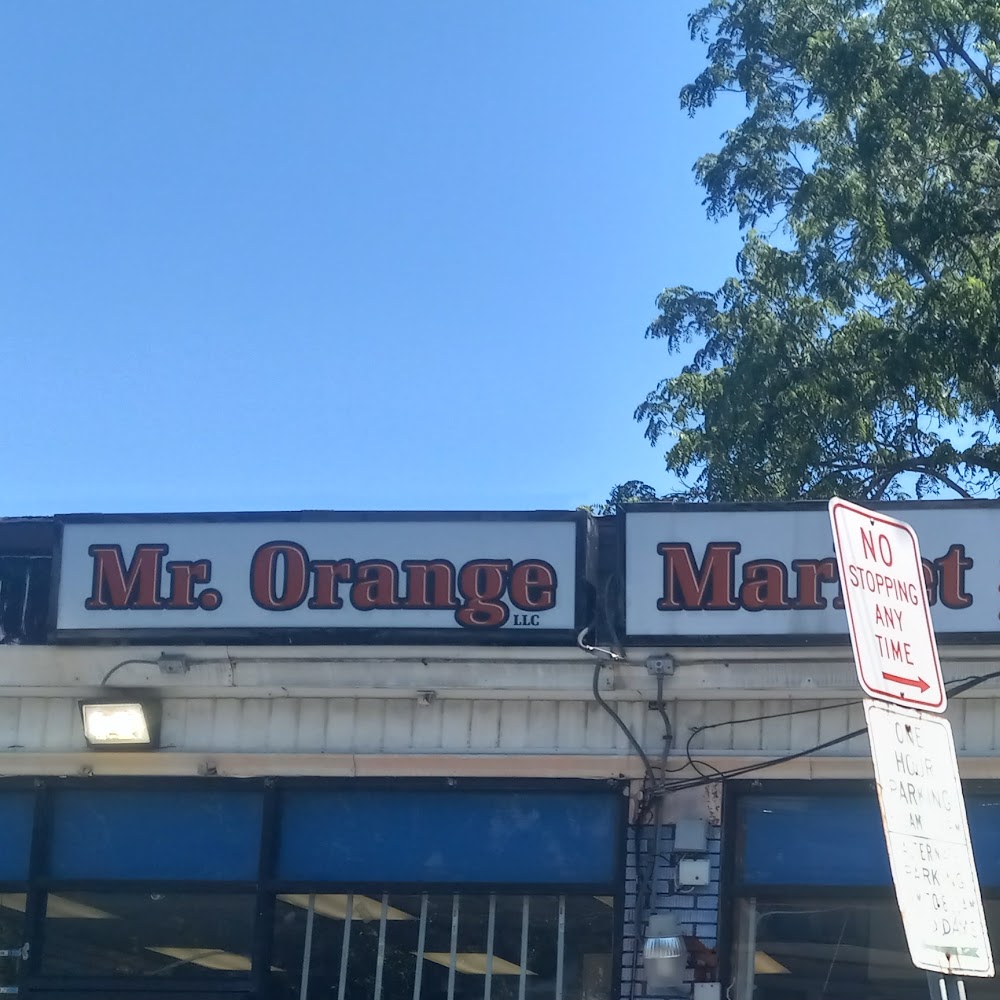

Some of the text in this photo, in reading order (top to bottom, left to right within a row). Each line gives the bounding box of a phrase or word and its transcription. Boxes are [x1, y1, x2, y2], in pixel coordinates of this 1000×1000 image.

[860, 527, 893, 567] NO
[85, 540, 558, 629] Mr. Orange
[657, 541, 973, 612] Mart
[849, 564, 919, 606] STOPPING
[513, 614, 540, 627] LLC
[875, 604, 903, 632] ANY
[875, 634, 914, 666] TIME
